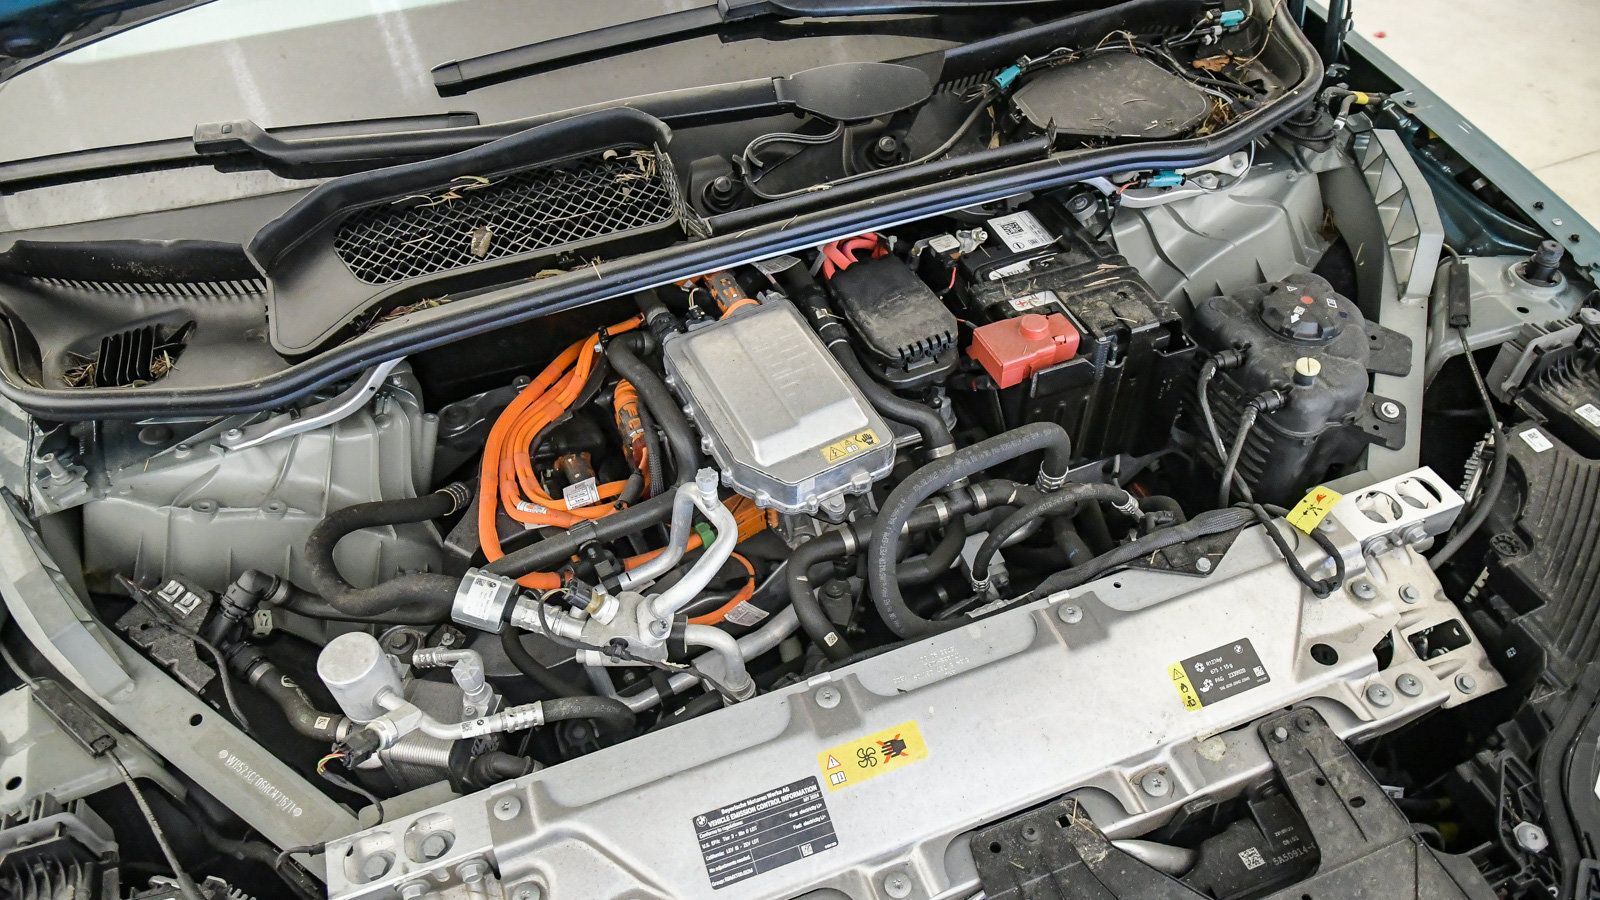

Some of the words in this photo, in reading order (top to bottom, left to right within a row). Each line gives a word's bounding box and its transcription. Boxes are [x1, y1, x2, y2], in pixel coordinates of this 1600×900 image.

[708, 815, 731, 828] VEHICLE
[731, 806, 757, 820] EMISSION
[756, 798, 781, 811] CONTROL
[781, 785, 818, 802] INFORMATION
[721, 802, 747, 815] Bayerische
[747, 794, 768, 806] Motoren
[767, 789, 783, 799] Werke
